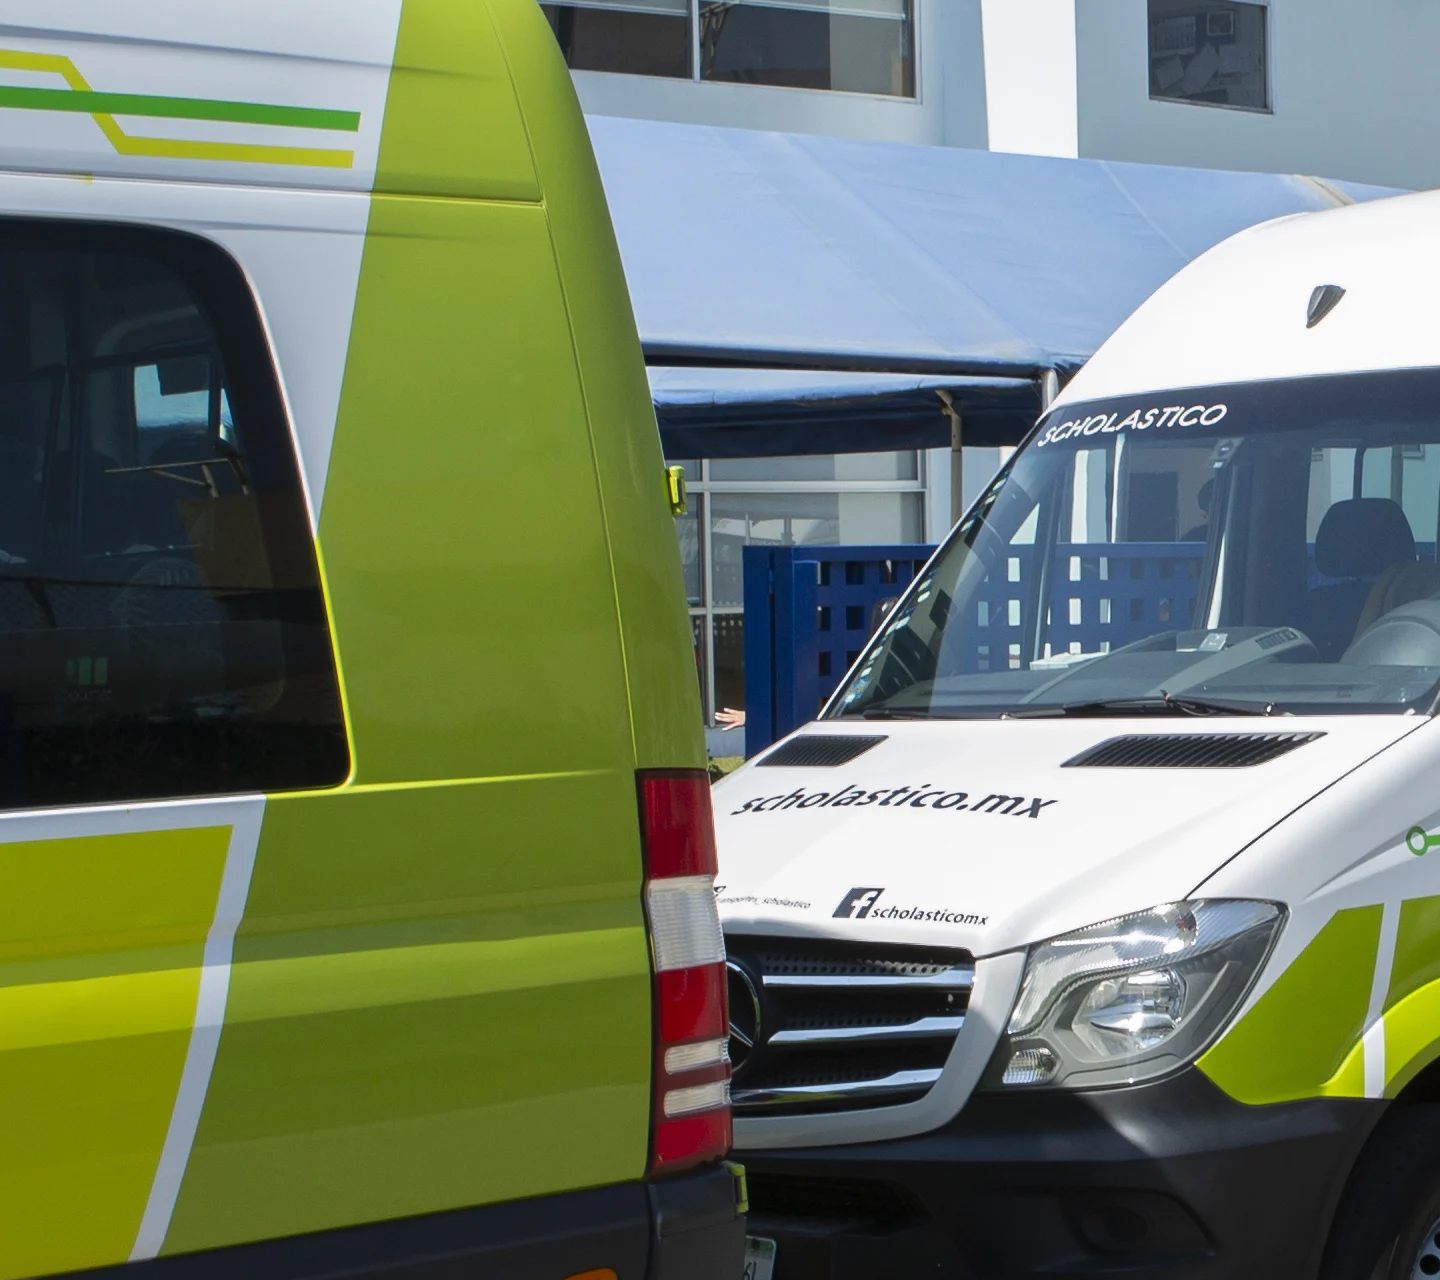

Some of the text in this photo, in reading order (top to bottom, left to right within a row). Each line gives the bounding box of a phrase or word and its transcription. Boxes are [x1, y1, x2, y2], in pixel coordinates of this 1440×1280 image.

[1037, 404, 1228, 447] SCHOLASTICO
[730, 783, 1058, 819] scholastico.mx
[871, 906, 989, 926] scholasticomx
